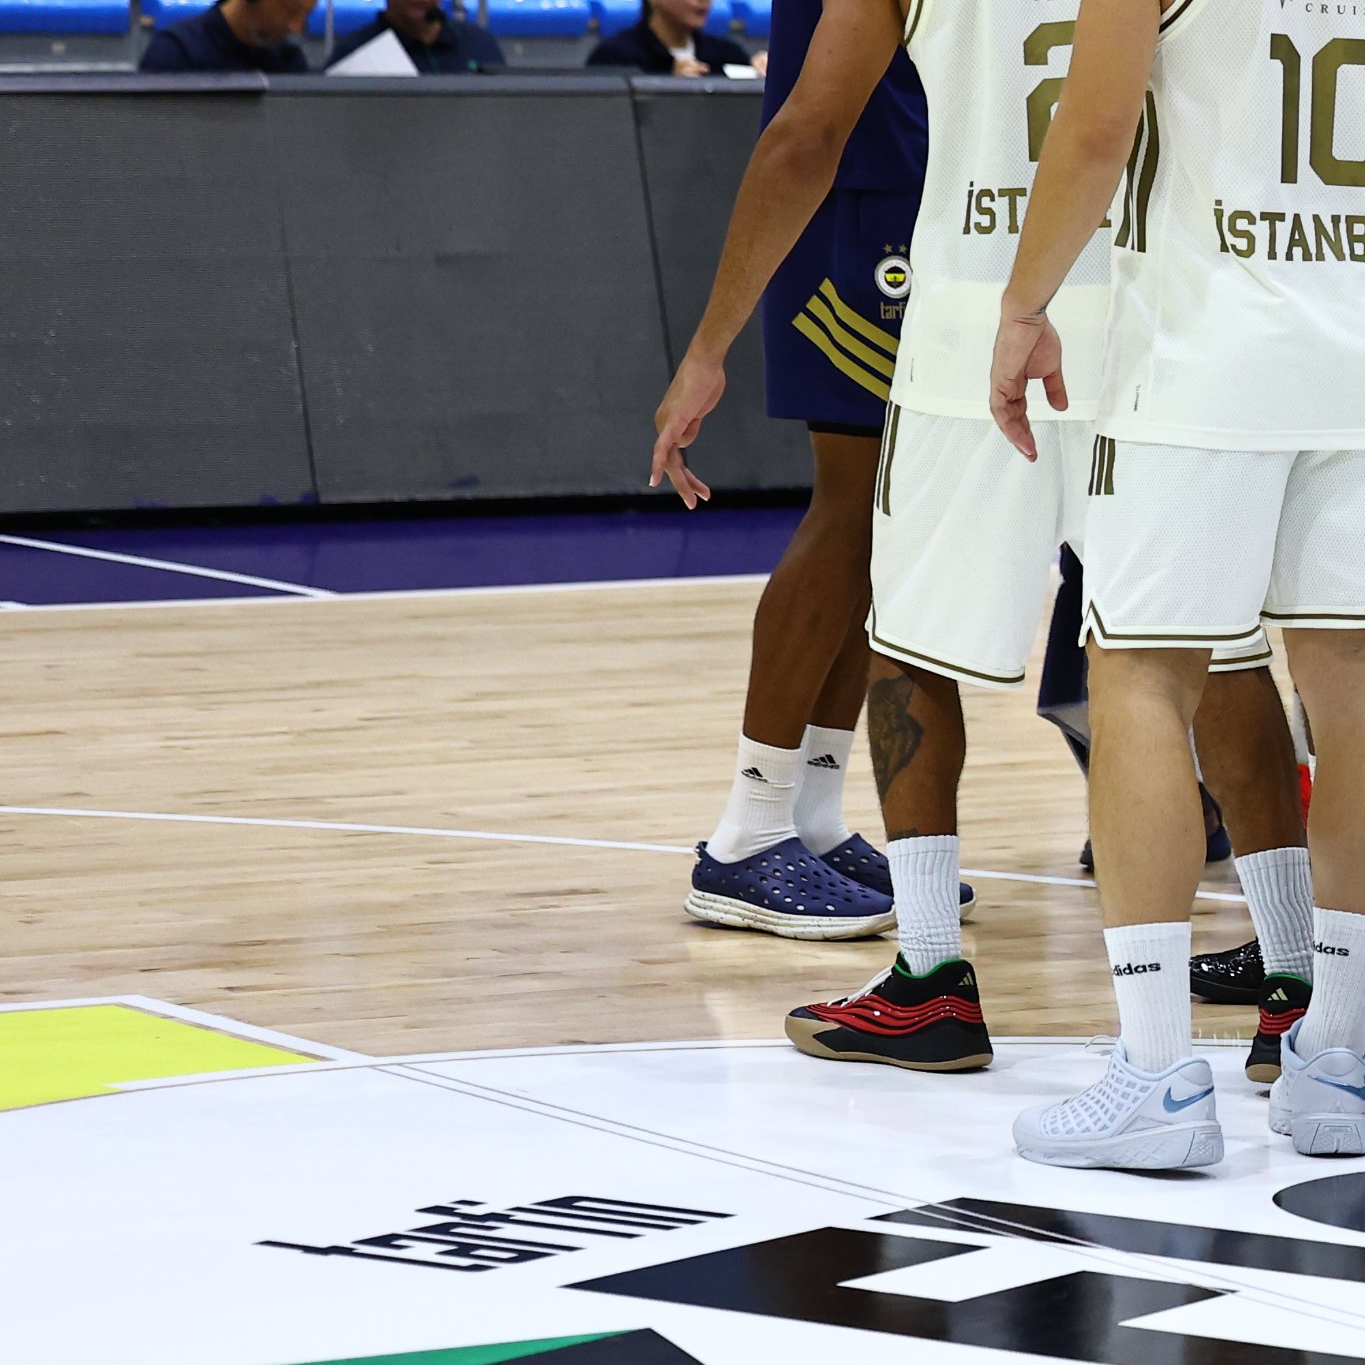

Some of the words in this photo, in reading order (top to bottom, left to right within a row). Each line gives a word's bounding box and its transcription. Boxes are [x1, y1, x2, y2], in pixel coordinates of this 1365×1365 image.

[880, 301, 906, 320] tarf
[1111, 961, 1162, 977] didas
[252, 1195, 739, 1273] tarfin
